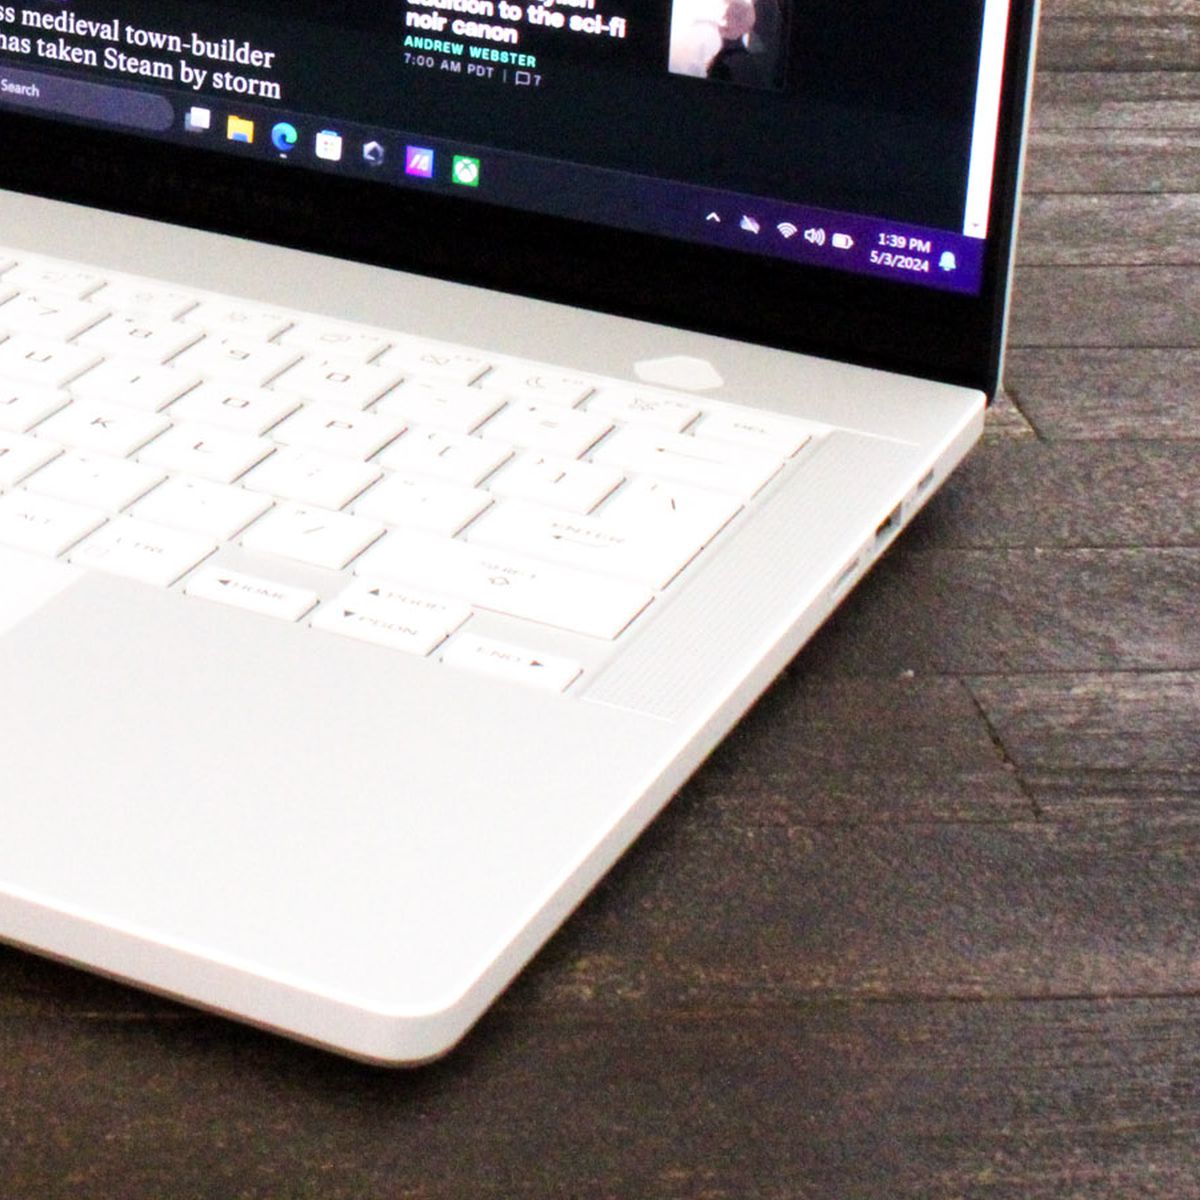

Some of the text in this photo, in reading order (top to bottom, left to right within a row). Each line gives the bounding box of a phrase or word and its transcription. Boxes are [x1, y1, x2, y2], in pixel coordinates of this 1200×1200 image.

[405, 14, 517, 44] noir canon
[499, 1, 521, 22] to
[527, 5, 564, 29] the
[570, 16, 626, 38] sci-fi
[21, 9, 119, 42] medieval
[125, 22, 275, 69] town-builder
[404, 35, 535, 68] ANDREW WEBSTER
[37, 36, 97, 67] taken
[104, 50, 174, 81] Steam
[180, 60, 207, 91] by
[212, 72, 281, 100] storm
[404, 54, 541, 86] 7:00 AM PDT 7
[1, 78, 40, 98] Search
[878, 233, 931, 253] 1:39 PM
[870, 251, 930, 272] 5/3/2024
